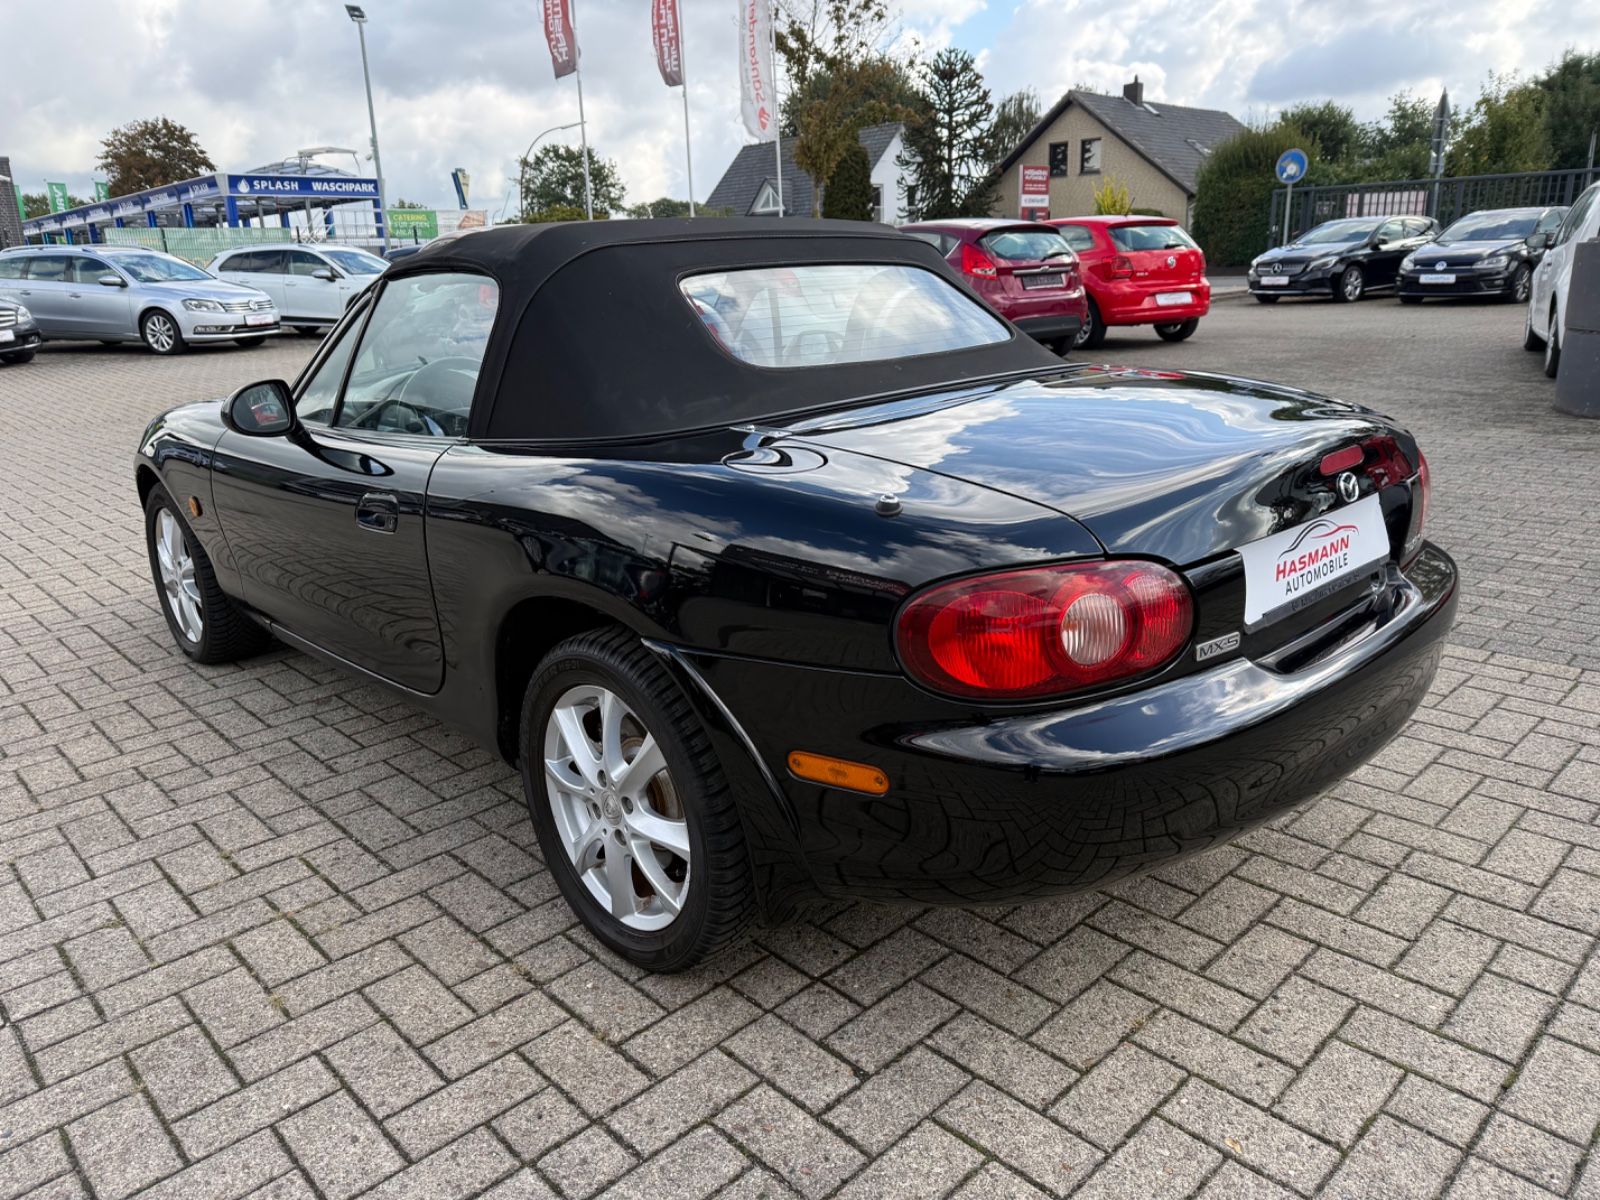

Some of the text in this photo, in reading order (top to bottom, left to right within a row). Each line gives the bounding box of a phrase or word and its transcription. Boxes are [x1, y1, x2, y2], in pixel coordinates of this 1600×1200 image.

[253, 180, 376, 193] SPLASH WASCHPARK
[1276, 535, 1350, 582] HASMANN
[1286, 553, 1349, 595] AUTOMOBILE
[1200, 634, 1240, 658] MX-5
